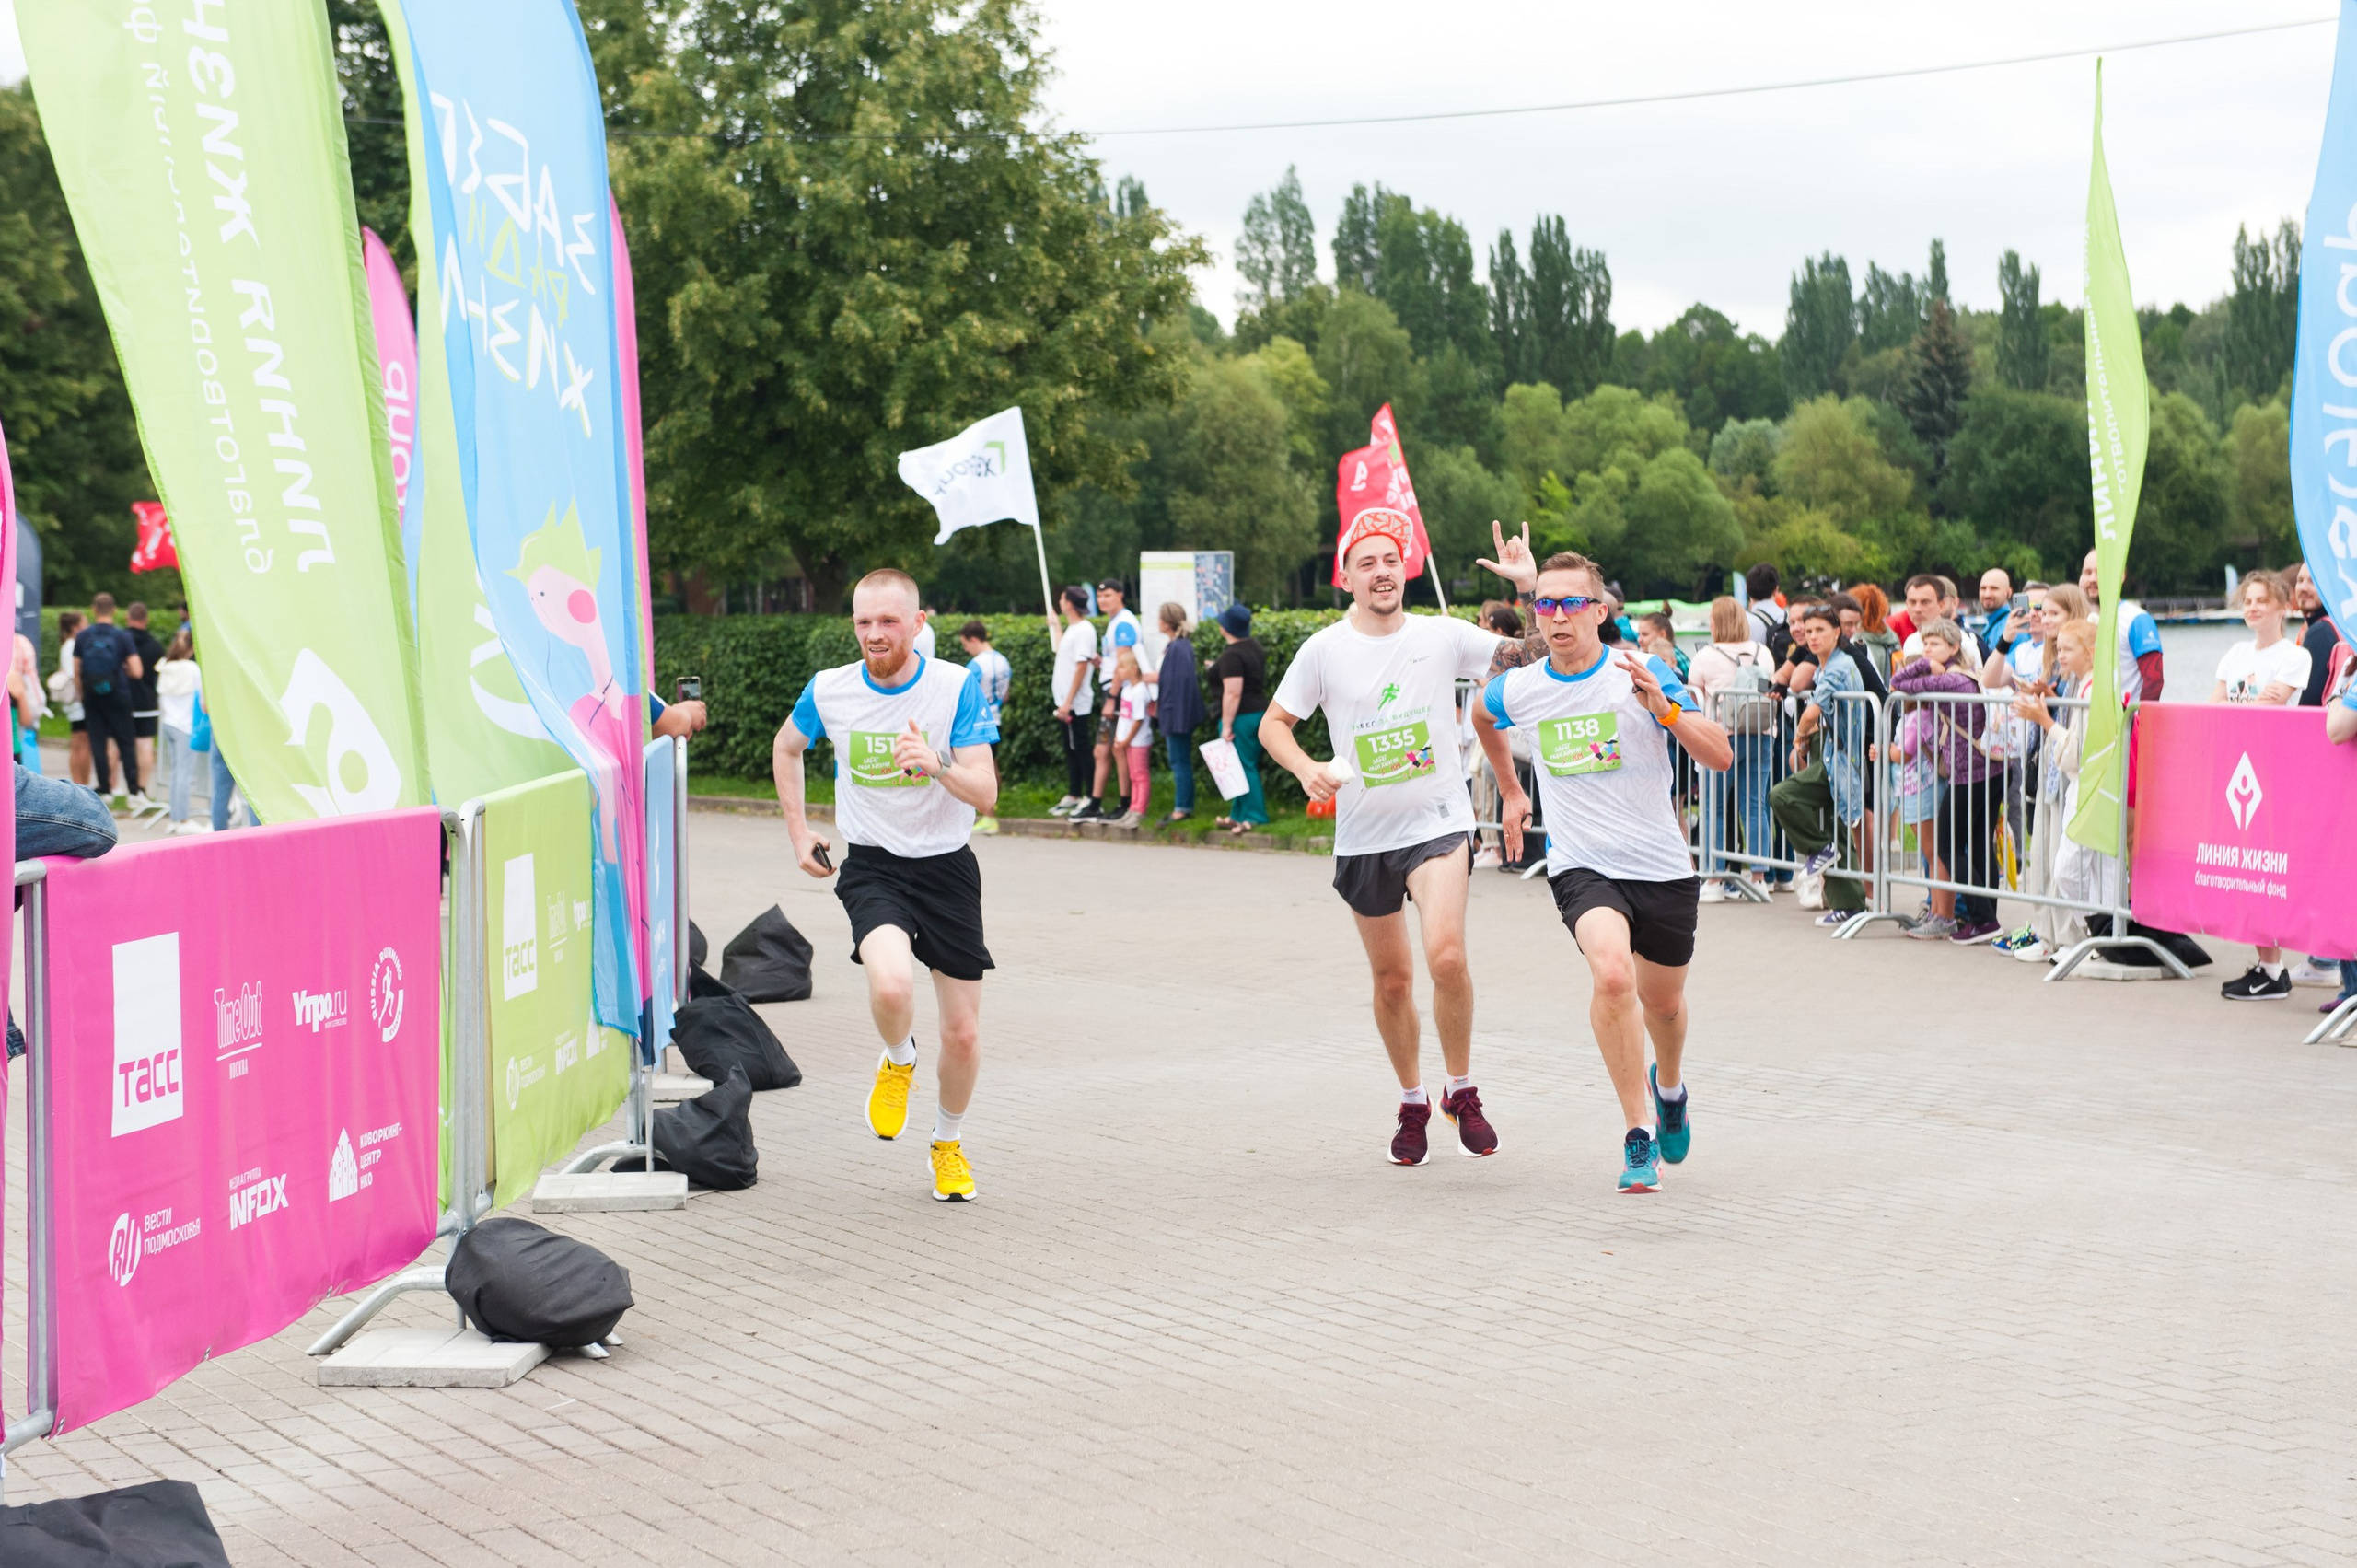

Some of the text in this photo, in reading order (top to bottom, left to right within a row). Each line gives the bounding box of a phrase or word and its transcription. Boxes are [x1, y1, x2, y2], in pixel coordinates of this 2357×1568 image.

[1367, 727, 1416, 754] 1335
[1553, 718, 1600, 741] 1138
[2195, 842, 2289, 875] ЛИНИЯ ЖИЗНИ
[2194, 869, 2287, 900] благотворительный фонд
[292, 989, 348, 1033] Утро.ru
[359, 1121, 403, 1149] КОВОРКИНГ-
[359, 1148, 383, 1171] ЦЕНТР
[359, 1171, 373, 1191] НКО
[229, 1172, 290, 1231] INFOX
[143, 1216, 202, 1258] ПОДМОСКОВЬЯ
